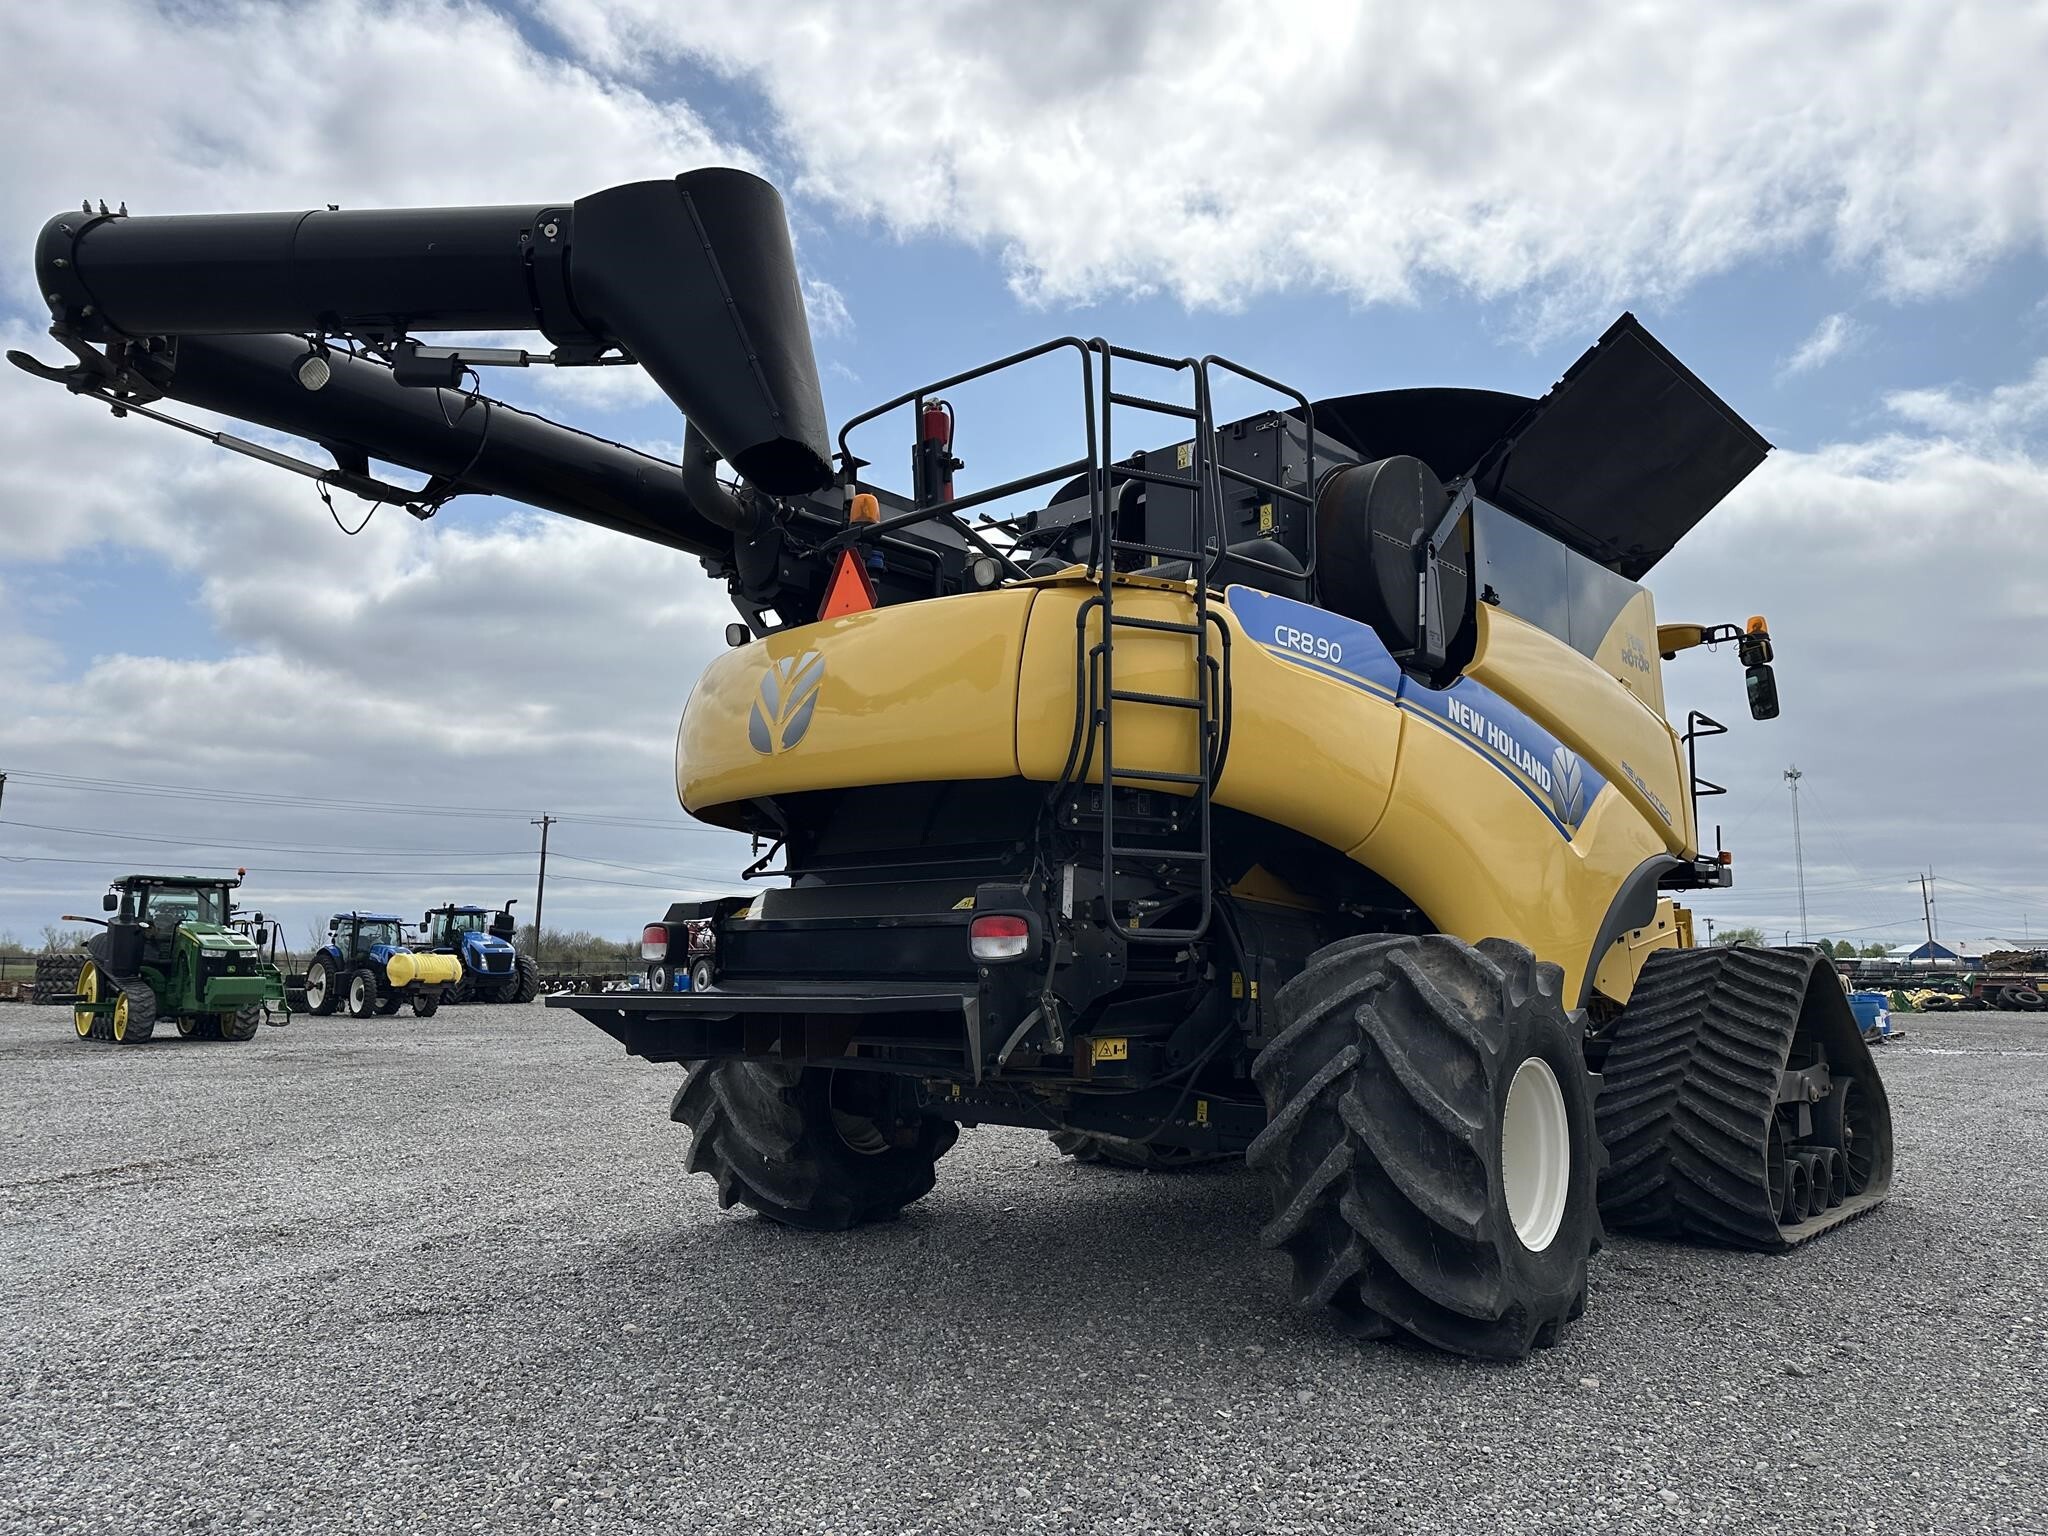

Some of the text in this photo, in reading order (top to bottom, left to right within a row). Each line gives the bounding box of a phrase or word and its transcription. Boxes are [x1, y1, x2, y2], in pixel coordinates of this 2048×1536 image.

[1275, 625, 1342, 664] CR8.90
[1622, 648, 1650, 673] ROTOR
[1448, 696, 1551, 792] NEW HOLLAND
